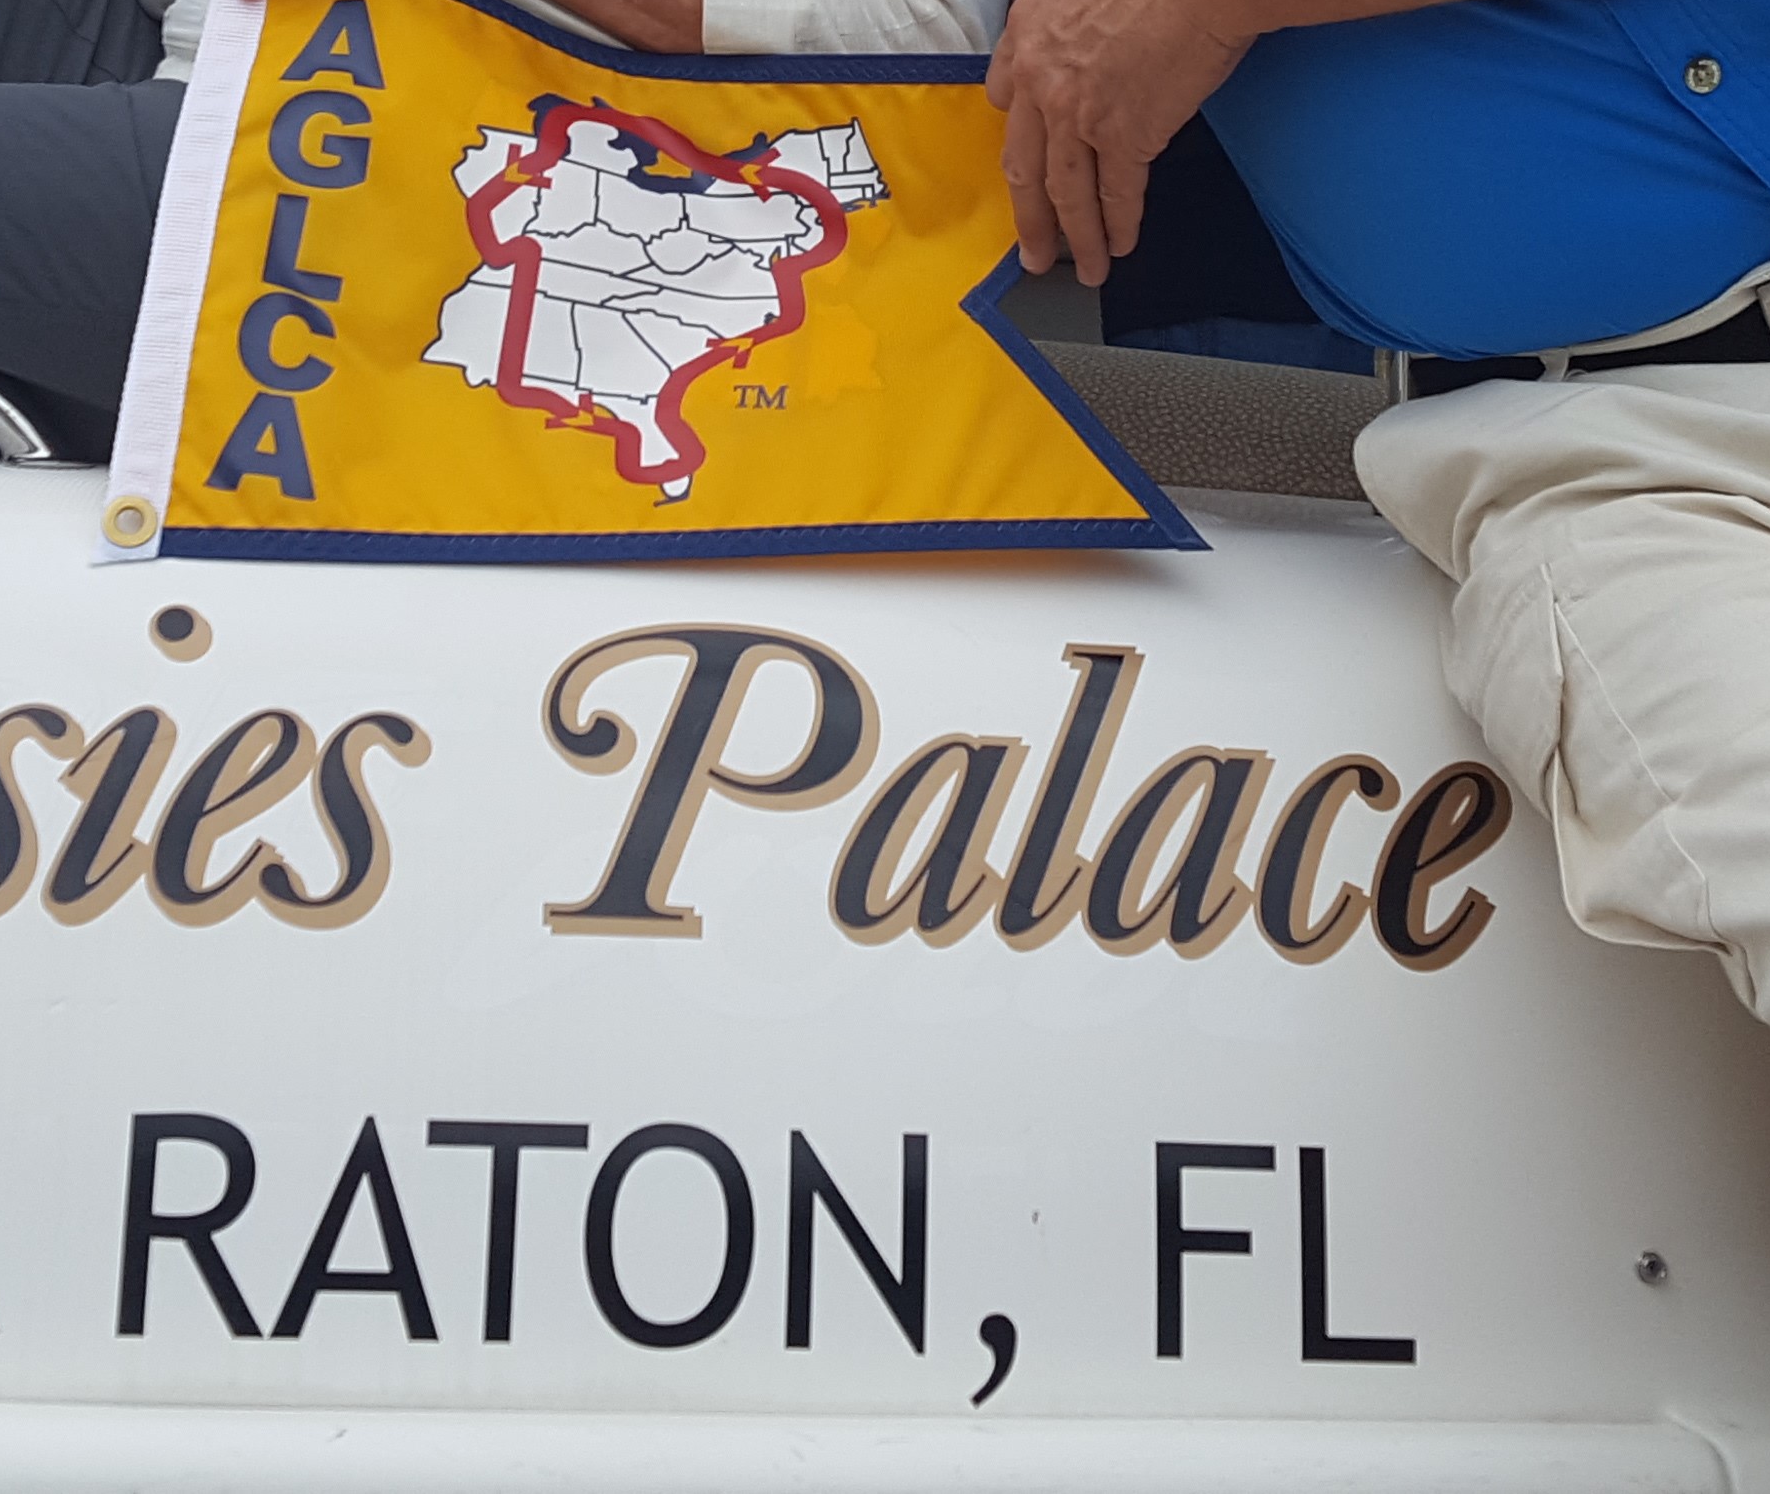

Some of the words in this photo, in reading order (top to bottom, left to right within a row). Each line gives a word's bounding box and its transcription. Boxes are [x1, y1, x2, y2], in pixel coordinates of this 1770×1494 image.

[733, 385, 786, 411] TM
[542, 622, 1512, 972] Palace
[115, 1112, 1019, 1406] RATON,
[1154, 1140, 1417, 1364] FL
